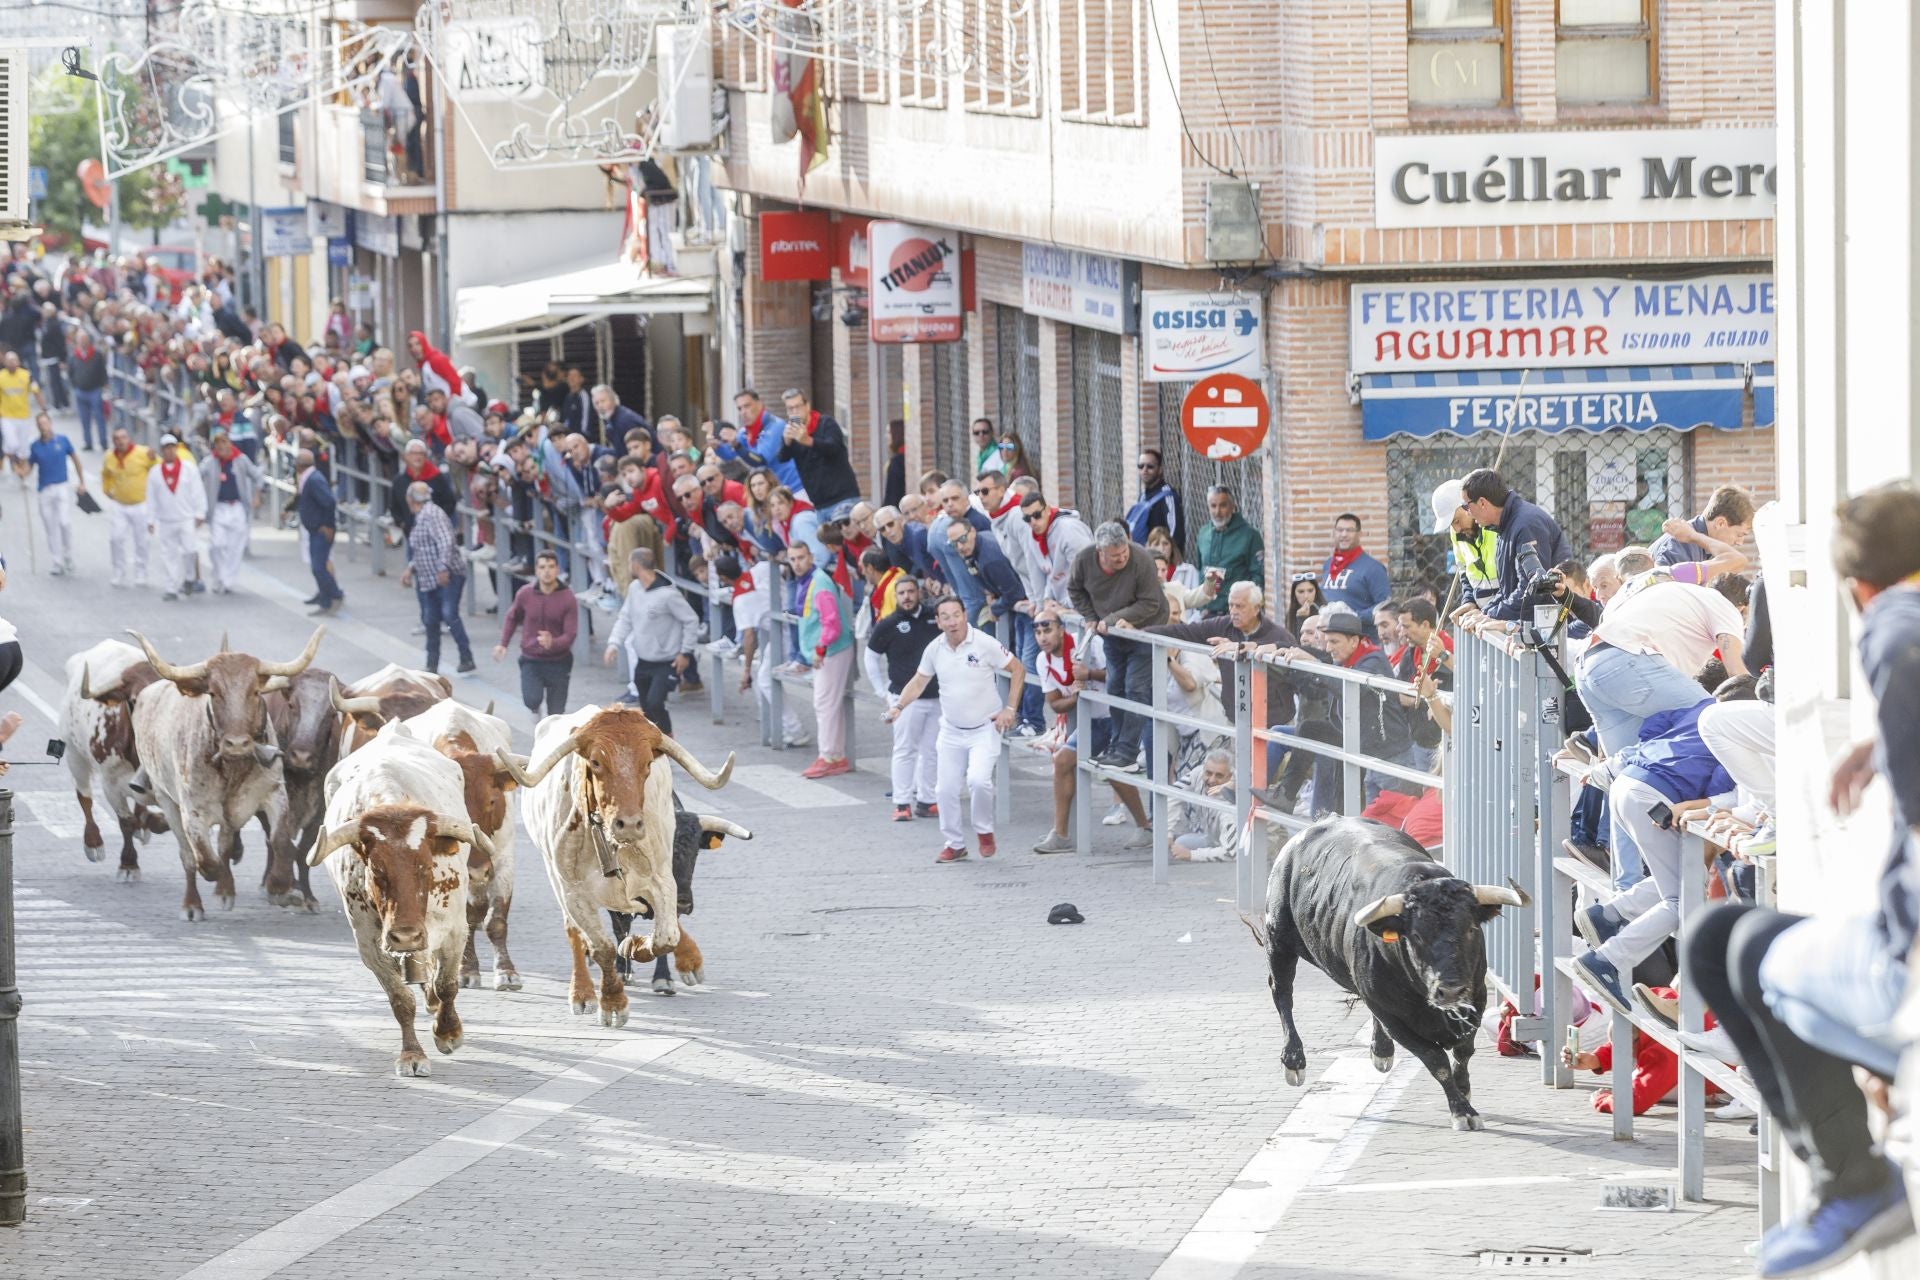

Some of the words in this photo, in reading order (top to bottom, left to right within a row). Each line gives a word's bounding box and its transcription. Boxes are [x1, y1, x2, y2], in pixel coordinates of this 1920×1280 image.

[1393, 155, 1621, 206] Cuéllar
[880, 238, 954, 292] TITANLUX
[1152, 309, 1226, 330] asisa
[1362, 287, 1584, 325] FERRETERIA
[1592, 285, 1621, 319] Y
[1634, 282, 1774, 317] MENAJE
[1375, 325, 1610, 363] AGUAMAR
[1621, 331, 1691, 349] ISIDORO
[1703, 329, 1770, 348] AGUADO
[1448, 392, 1659, 429] FERRETERIA
